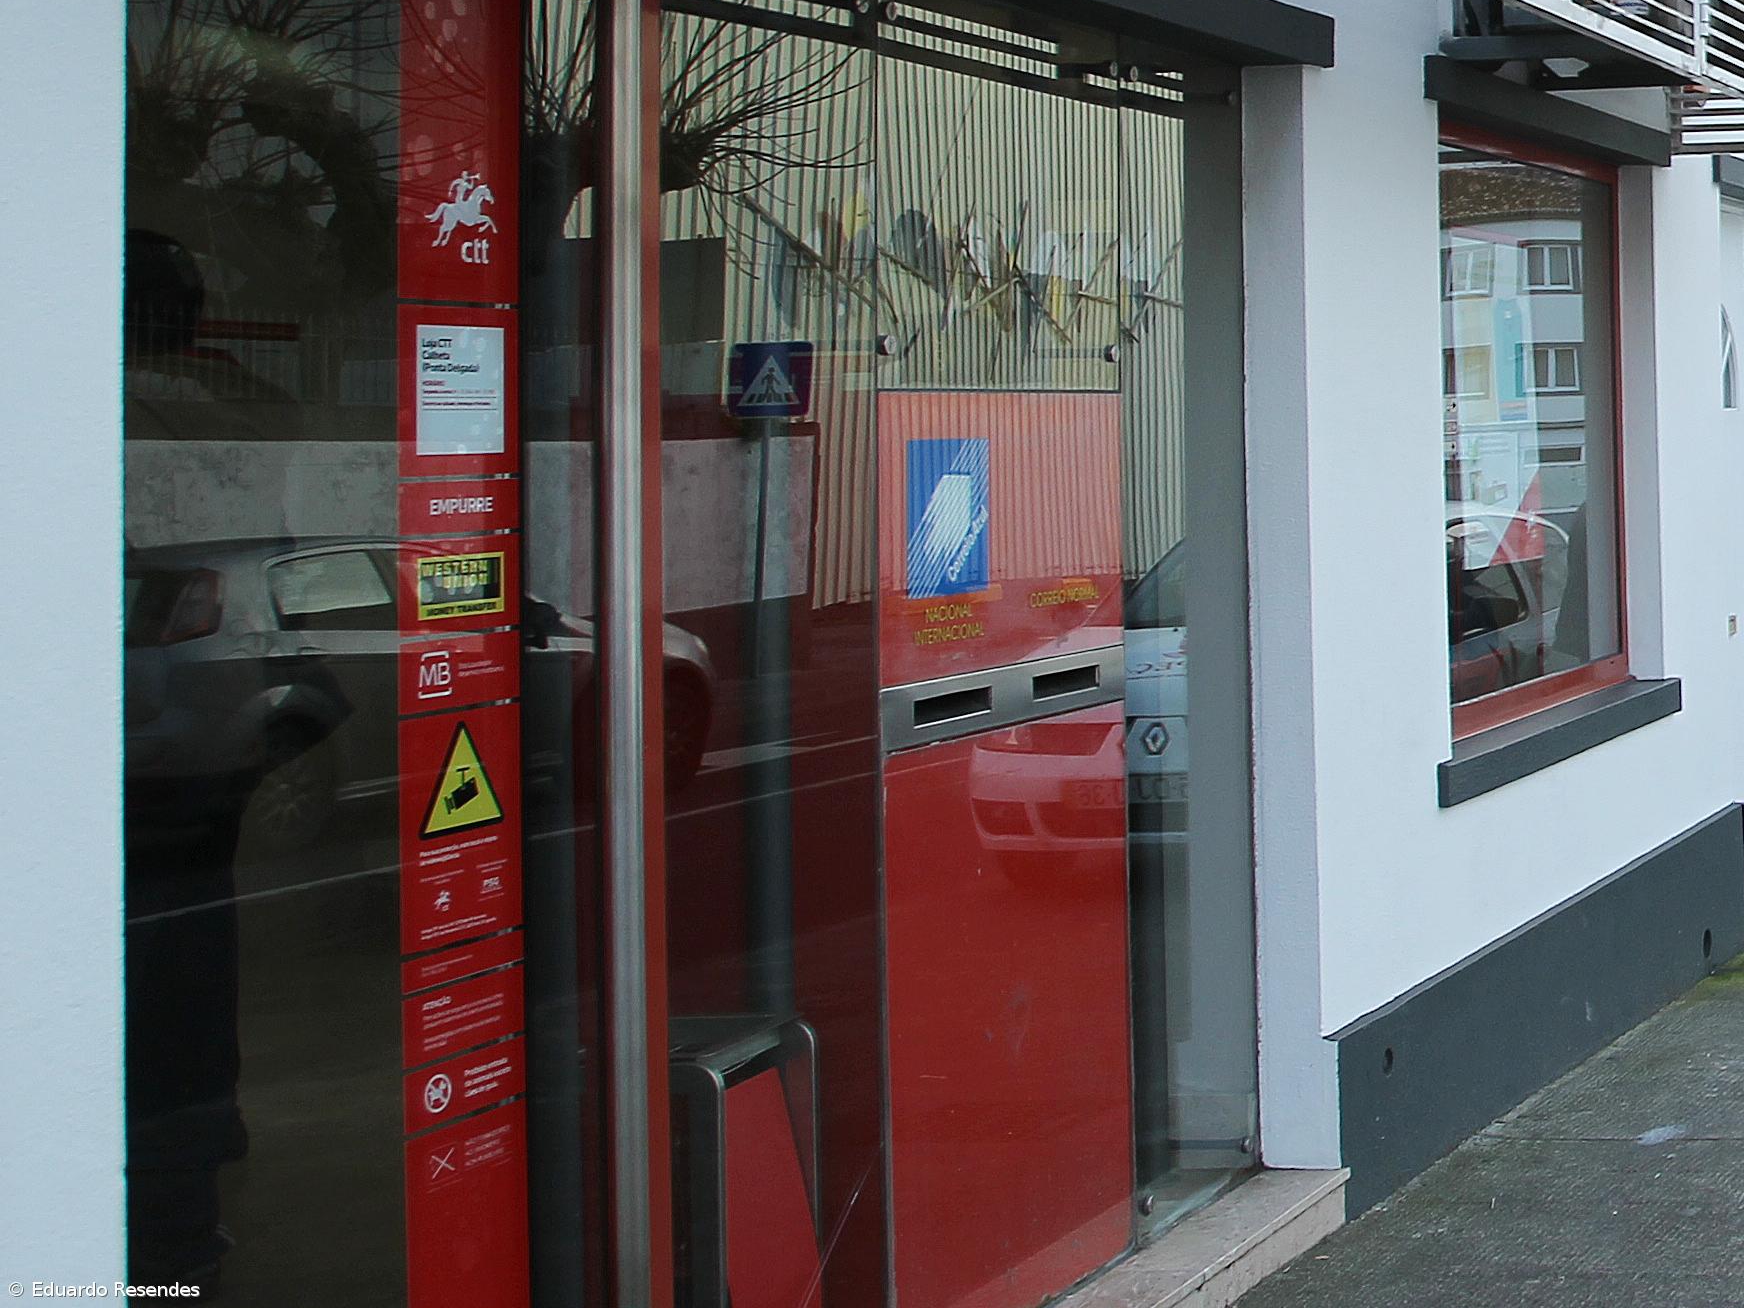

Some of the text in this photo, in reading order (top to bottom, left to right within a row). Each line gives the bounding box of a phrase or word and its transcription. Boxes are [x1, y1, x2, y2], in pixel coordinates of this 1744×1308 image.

[460, 237, 490, 265] ctt
[429, 496, 494, 517] EMPURRE
[421, 559, 488, 577] WESTERN
[443, 572, 488, 589] UNION
[1029, 585, 1099, 609] CORREIO NORMAL
[925, 602, 973, 624] NACIONAL
[913, 622, 985, 646] INTERNACIONAL
[419, 661, 452, 688] MB
